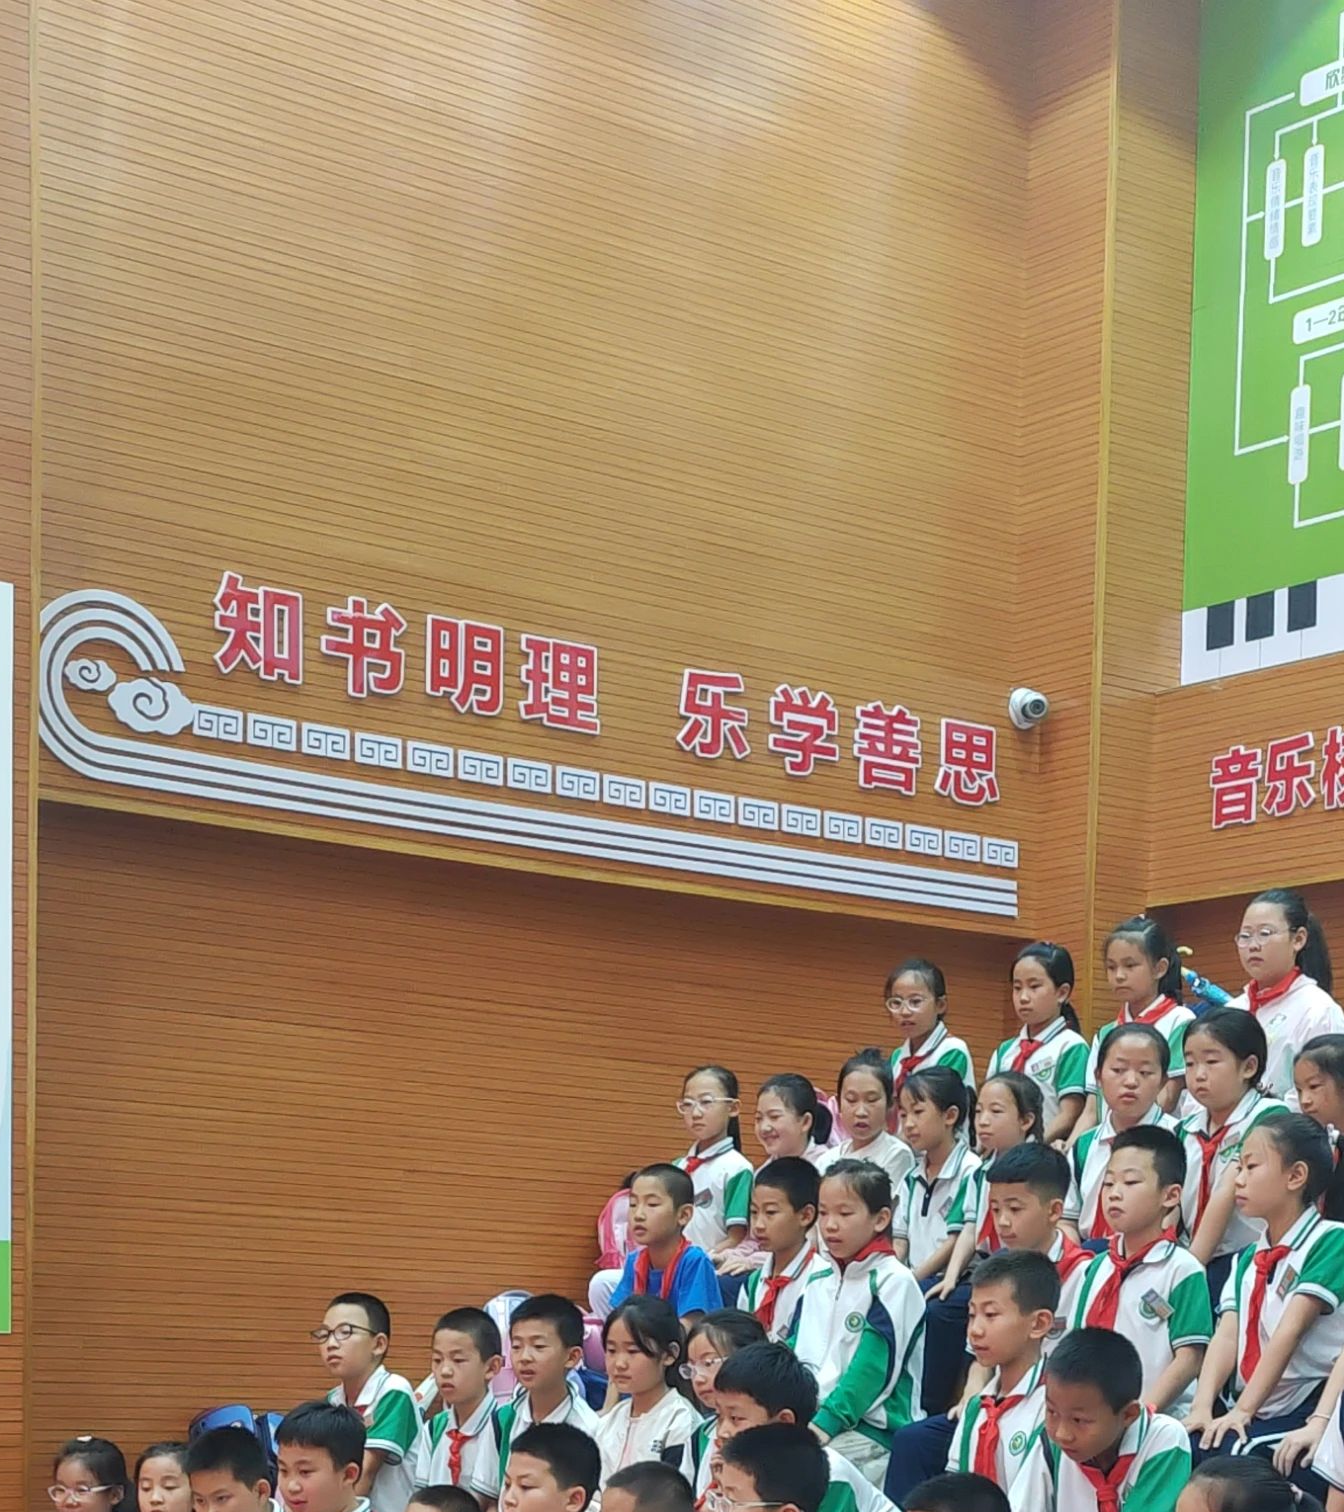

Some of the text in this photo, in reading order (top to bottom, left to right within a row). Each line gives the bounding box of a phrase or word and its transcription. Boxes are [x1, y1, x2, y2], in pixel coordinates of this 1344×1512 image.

[212, 571, 1002, 806] 知书明理 乐学善思
